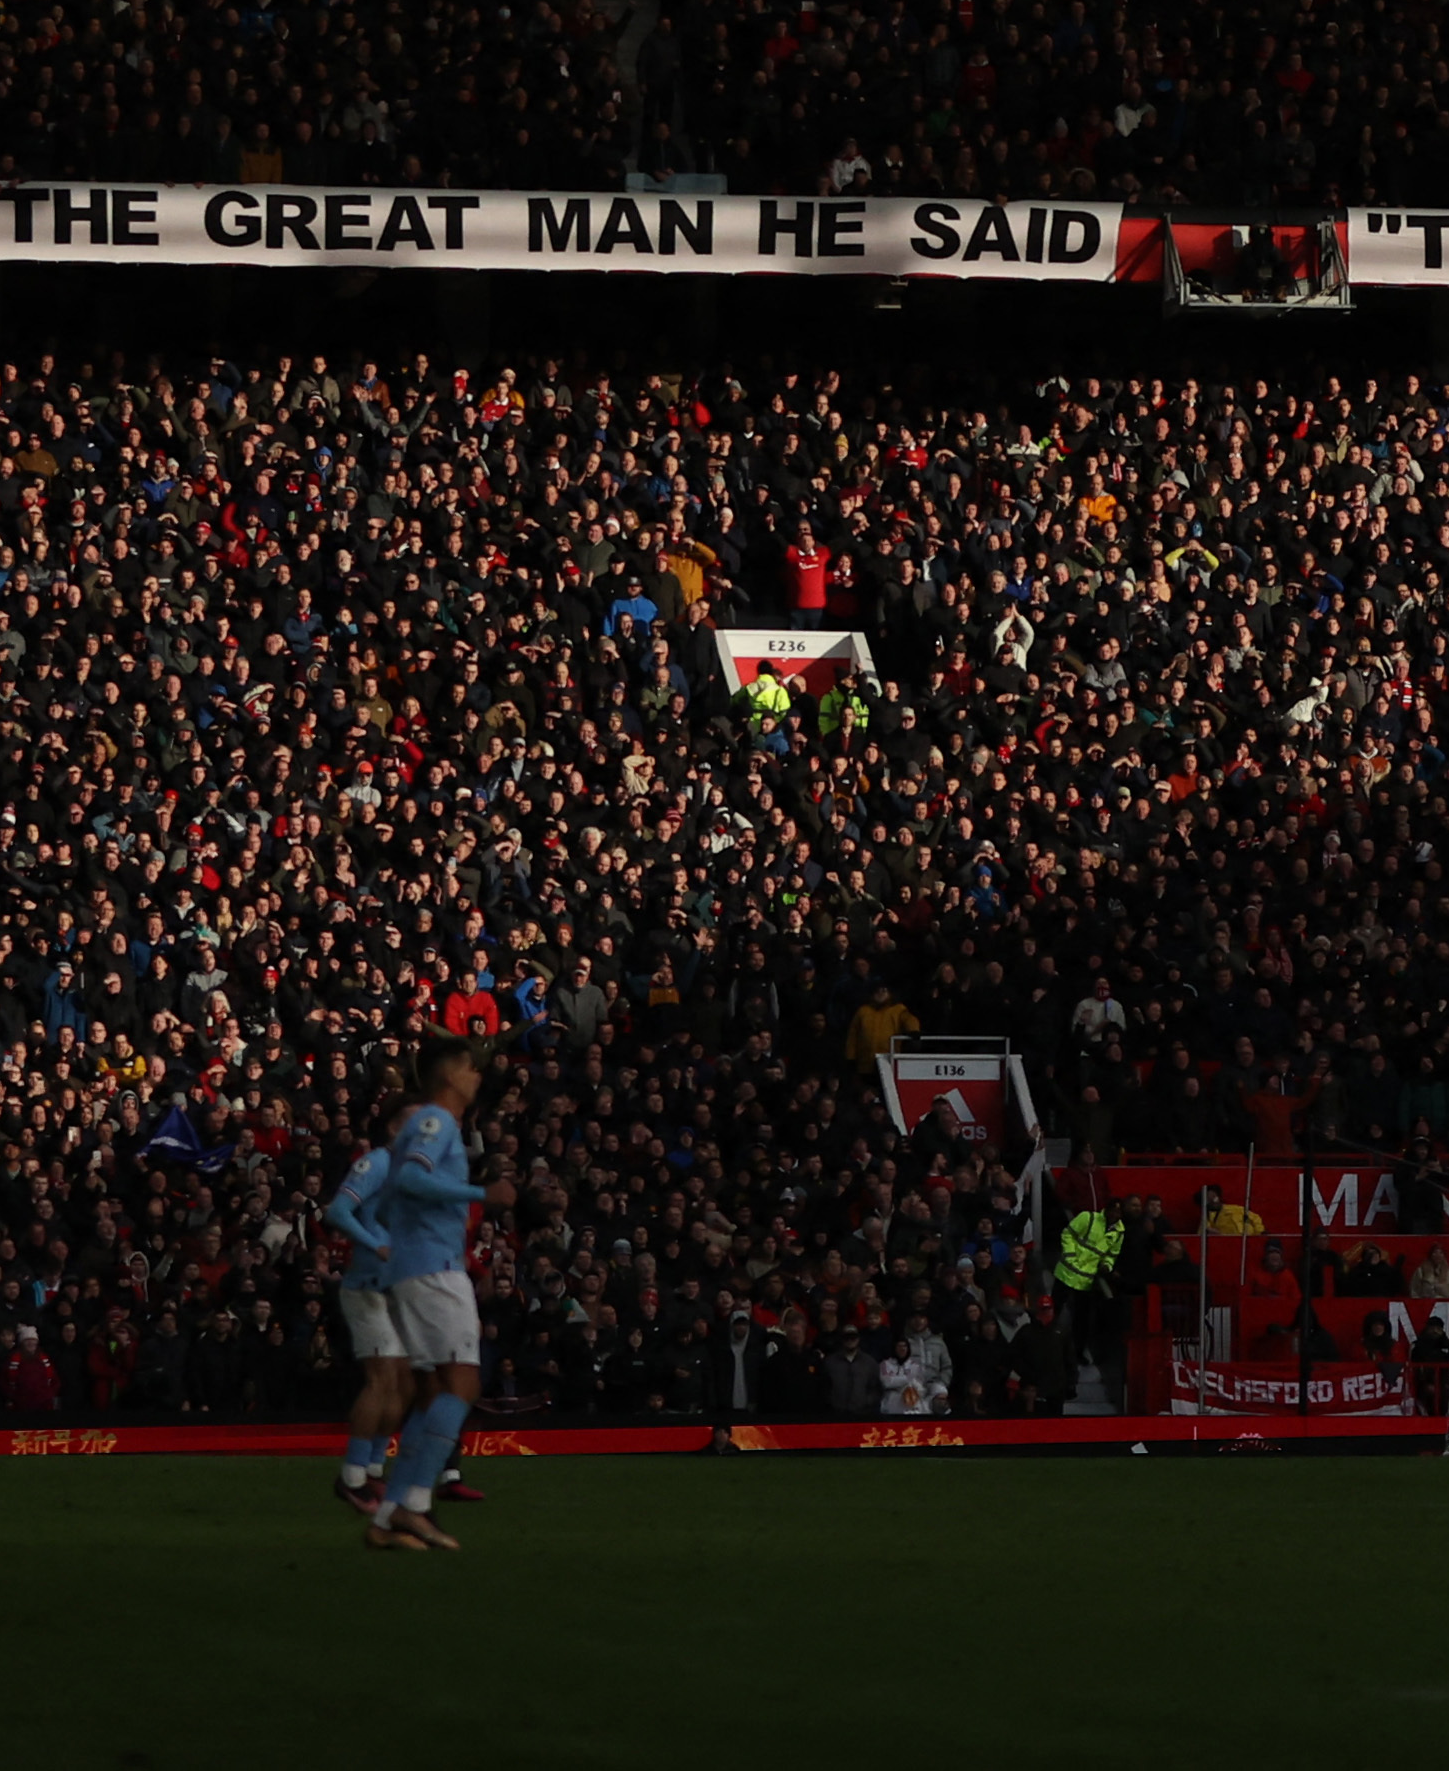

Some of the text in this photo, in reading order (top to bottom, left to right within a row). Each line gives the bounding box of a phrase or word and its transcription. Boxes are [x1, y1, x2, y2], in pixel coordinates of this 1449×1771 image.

[204, 191, 479, 252] GREAT
[527, 196, 714, 257] MAN
[757, 199, 867, 258] HE
[910, 203, 1102, 264] SAID
[768, 640, 806, 652] E236
[935, 1065, 966, 1076] E136
